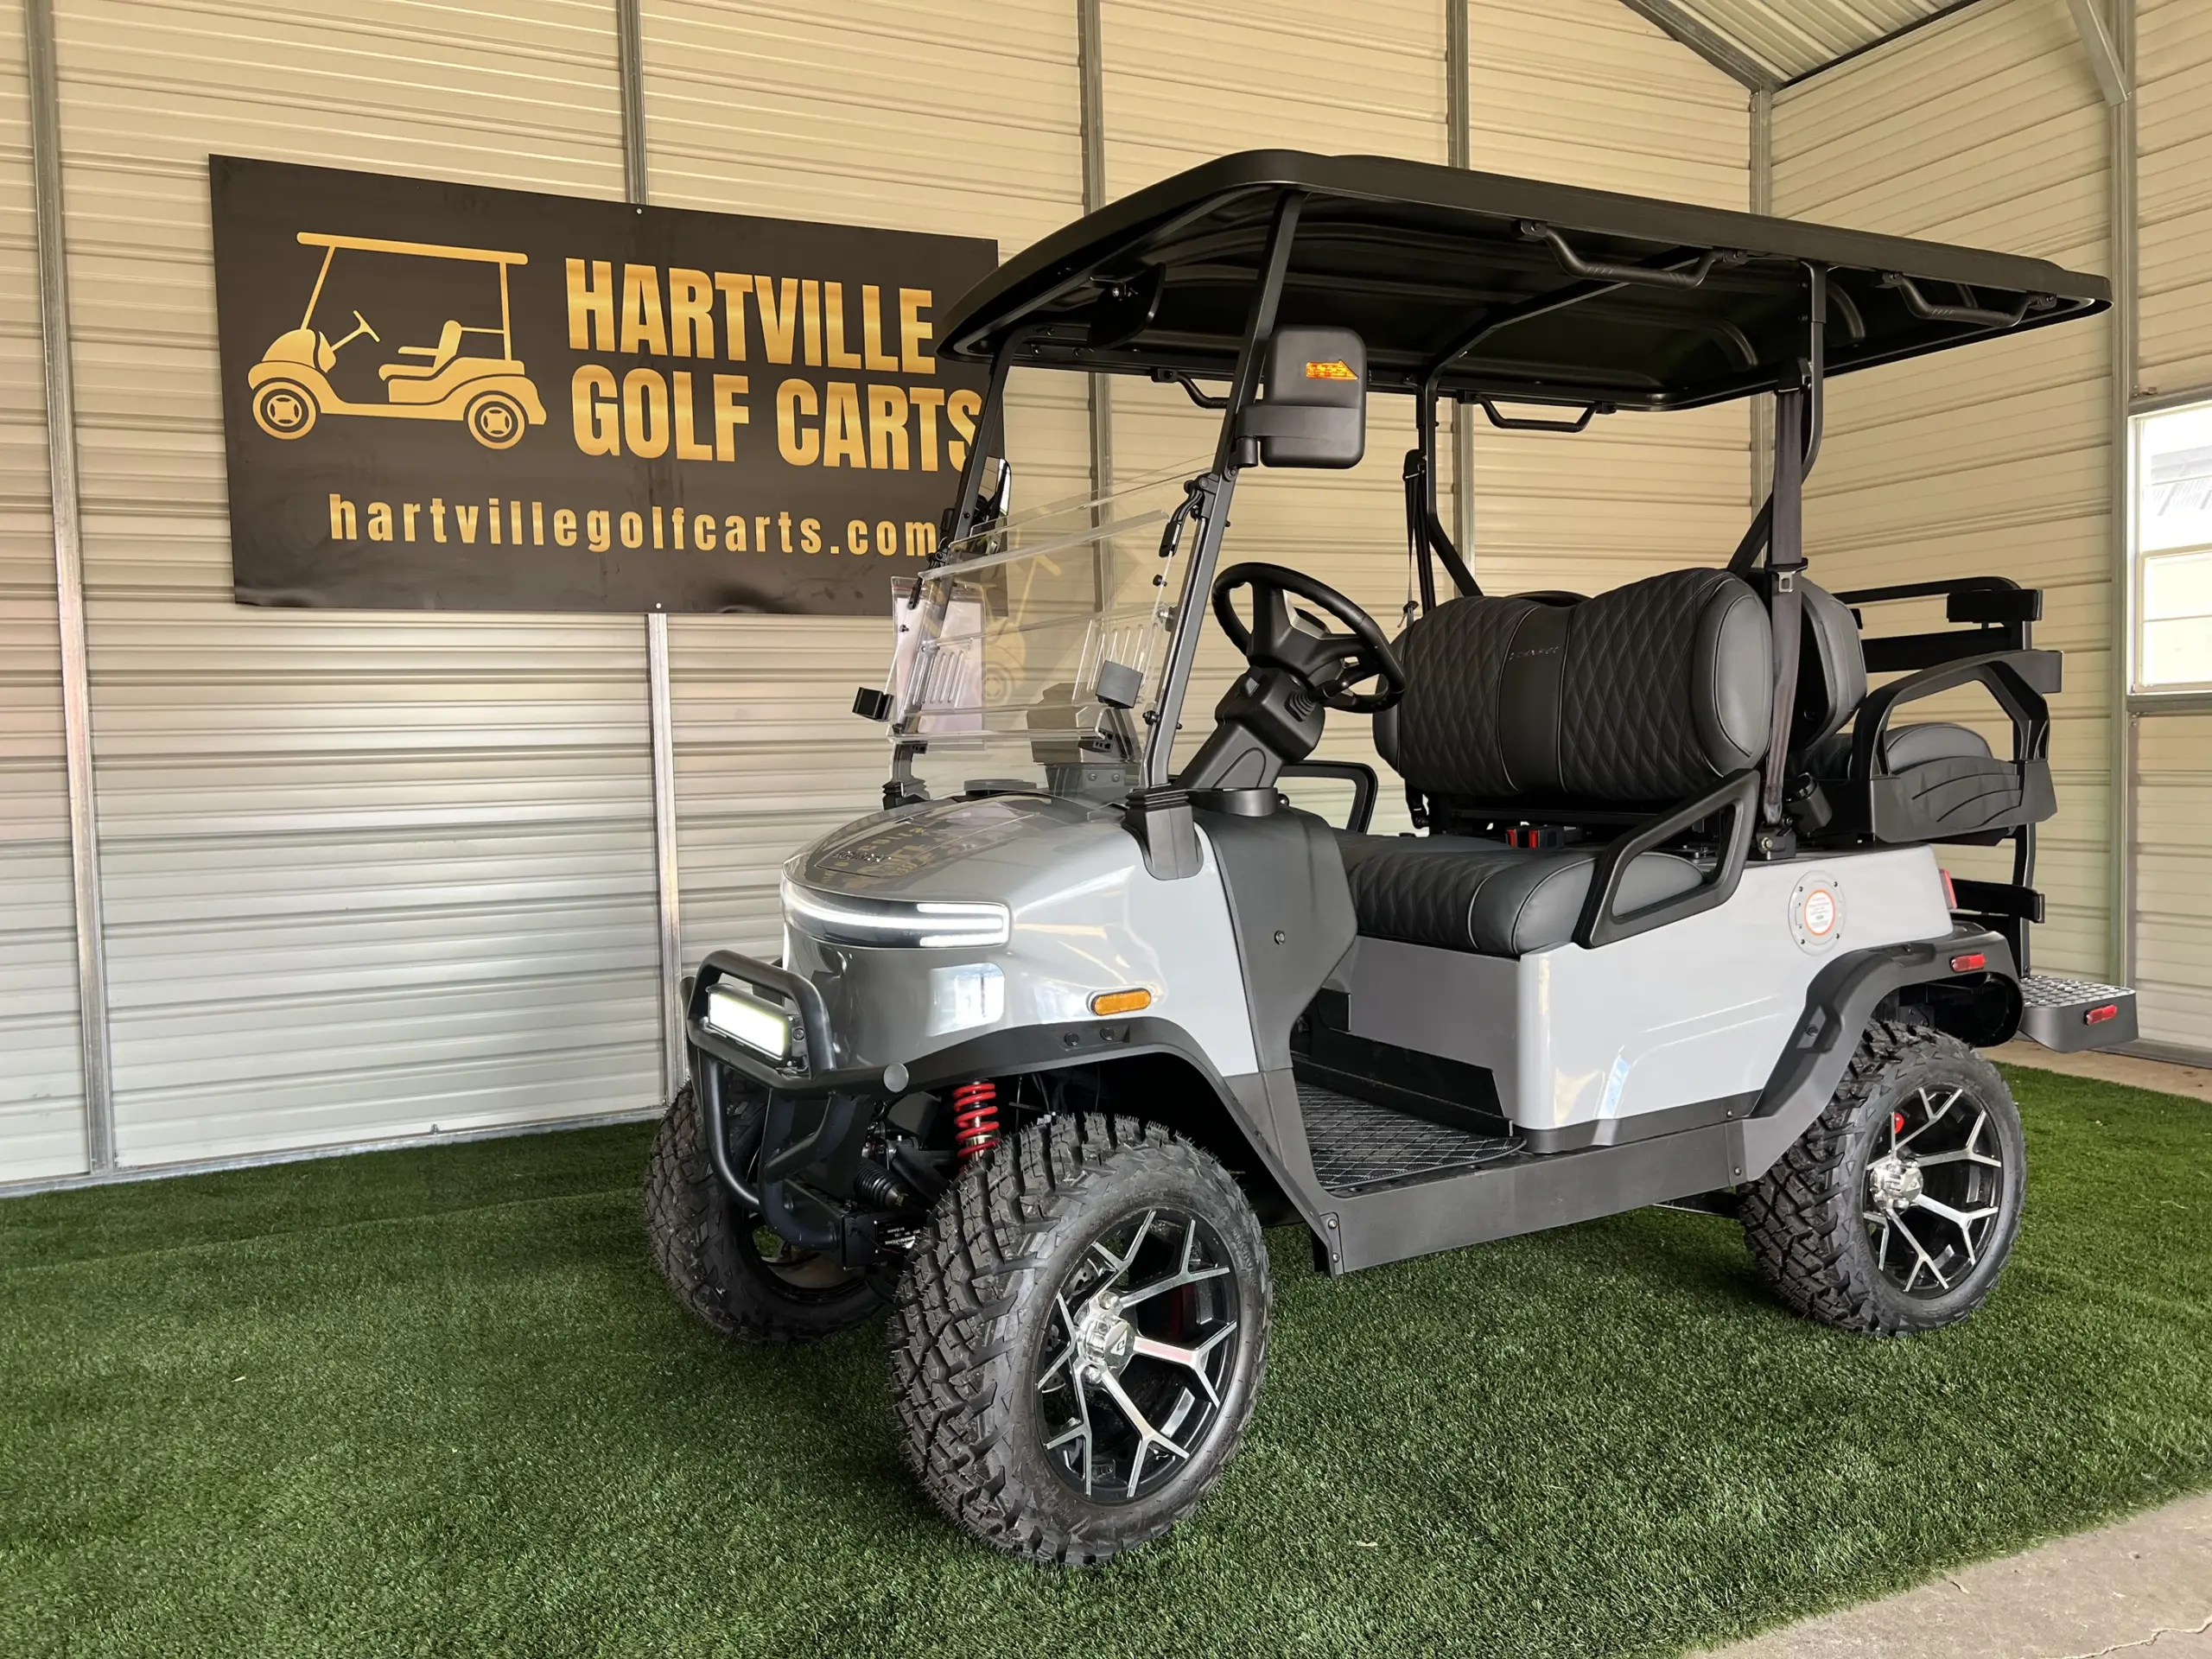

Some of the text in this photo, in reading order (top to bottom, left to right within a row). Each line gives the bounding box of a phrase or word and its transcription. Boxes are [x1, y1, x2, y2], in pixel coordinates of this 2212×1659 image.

[565, 257, 937, 374] HARTVILLE
[571, 364, 983, 473] GOLF CARTS
[328, 493, 938, 557] hartvillegolfcarts.com
